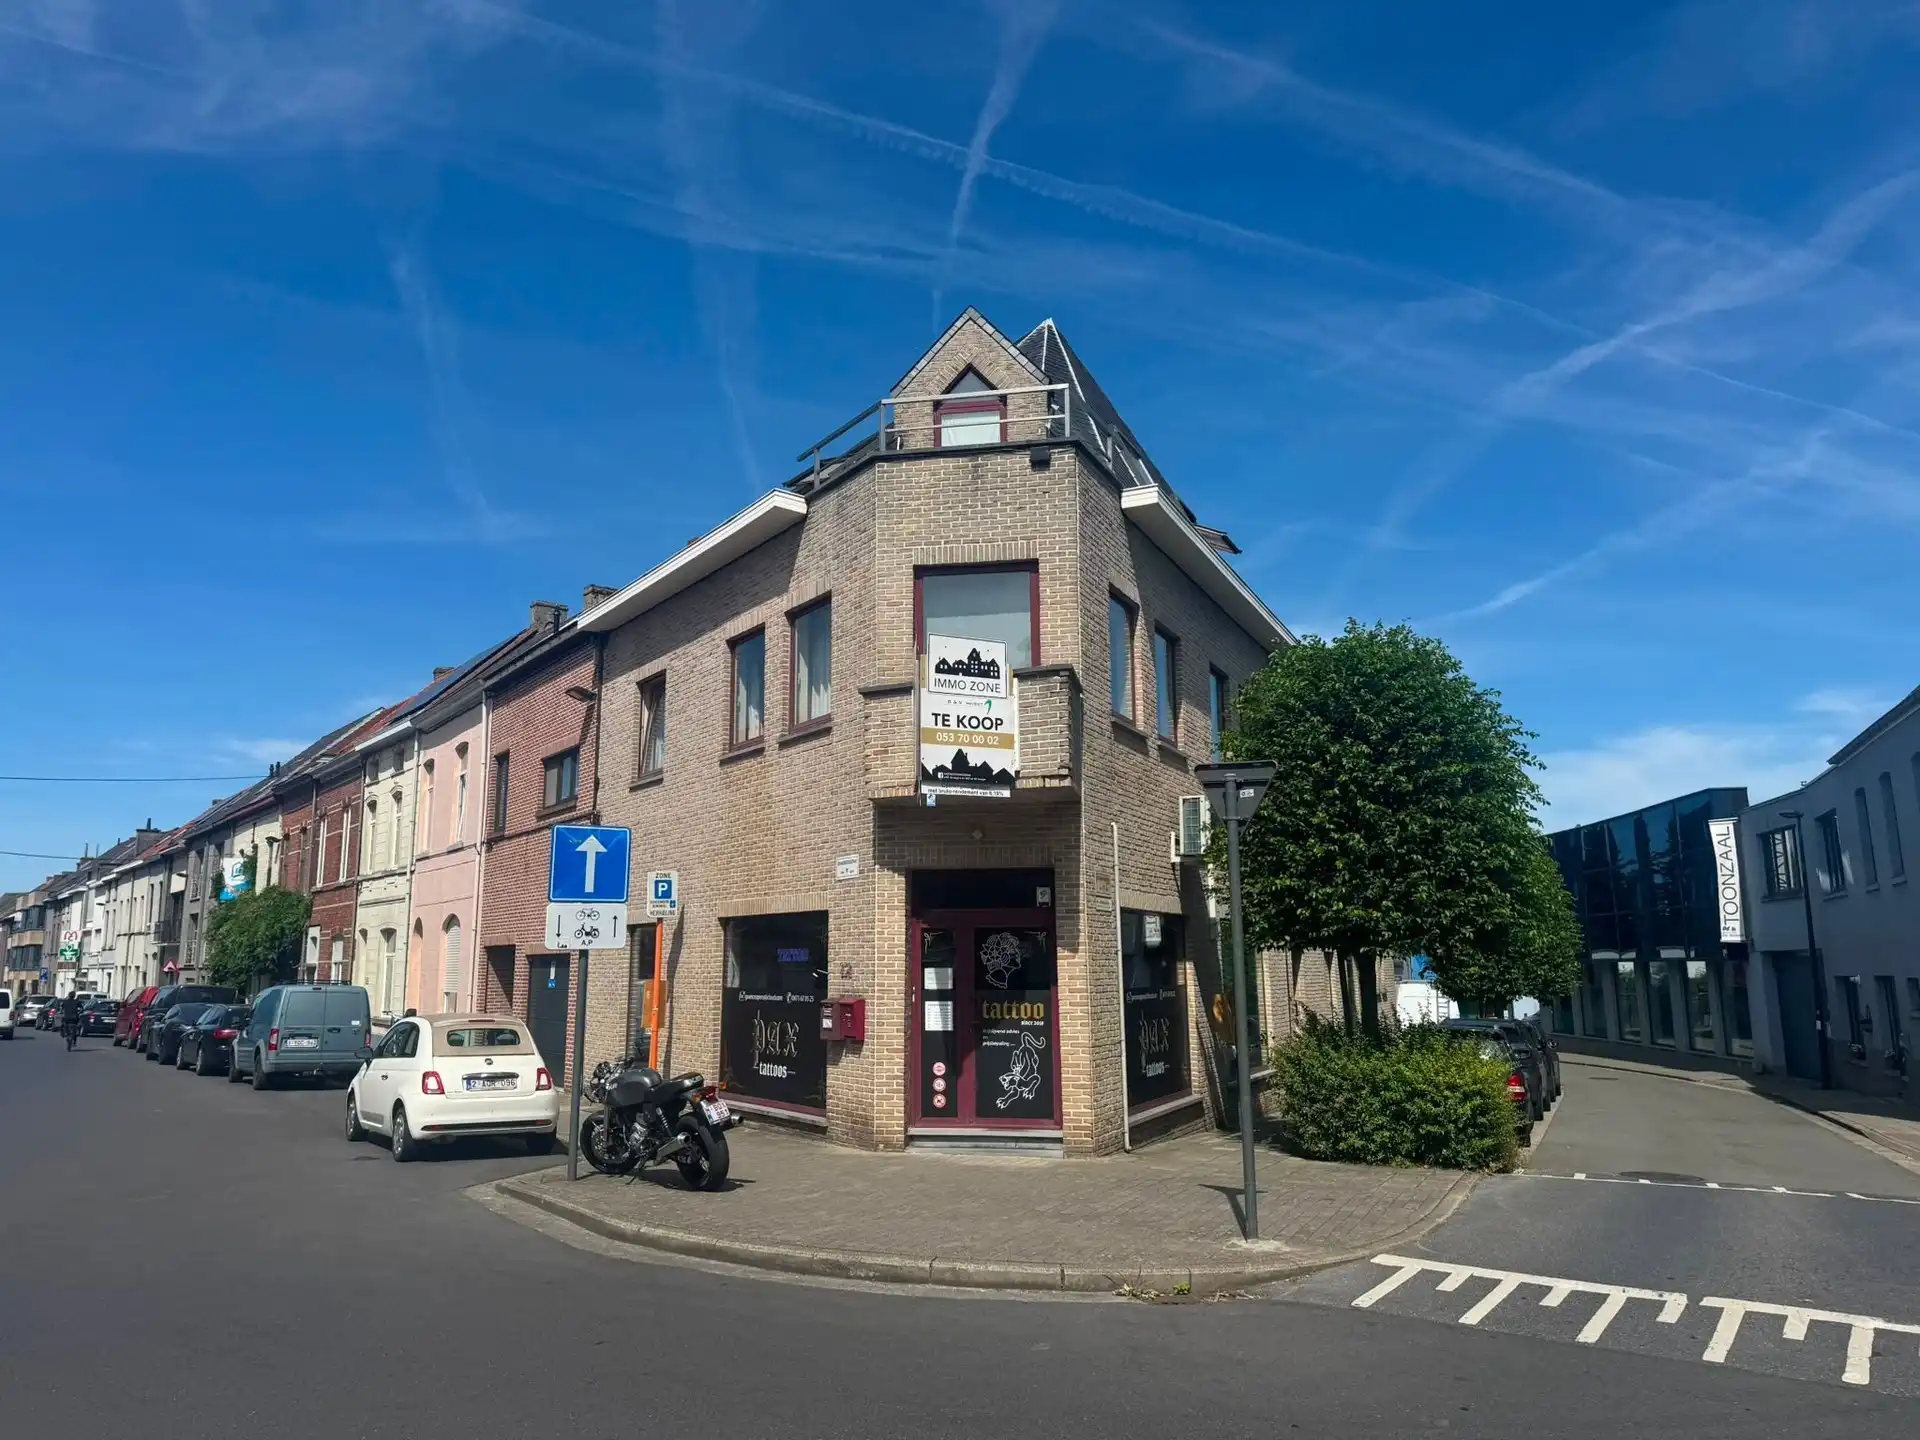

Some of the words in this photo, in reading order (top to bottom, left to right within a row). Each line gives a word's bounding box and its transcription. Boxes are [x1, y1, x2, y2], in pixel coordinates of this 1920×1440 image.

[934, 677, 967, 690] IMMO
[969, 680, 1001, 693] ZONE
[931, 712, 951, 727] TE
[956, 714, 1004, 731] KOOP
[936, 732, 954, 742] 053
[957, 733, 970, 743] 70
[972, 734, 985, 744] 00
[987, 735, 999, 745] 02
[1716, 826, 1739, 925] TOONZAAL
[658, 882, 668, 897] P
[982, 1000, 1045, 1019] tattoo
[759, 1061, 788, 1078] tattoos
